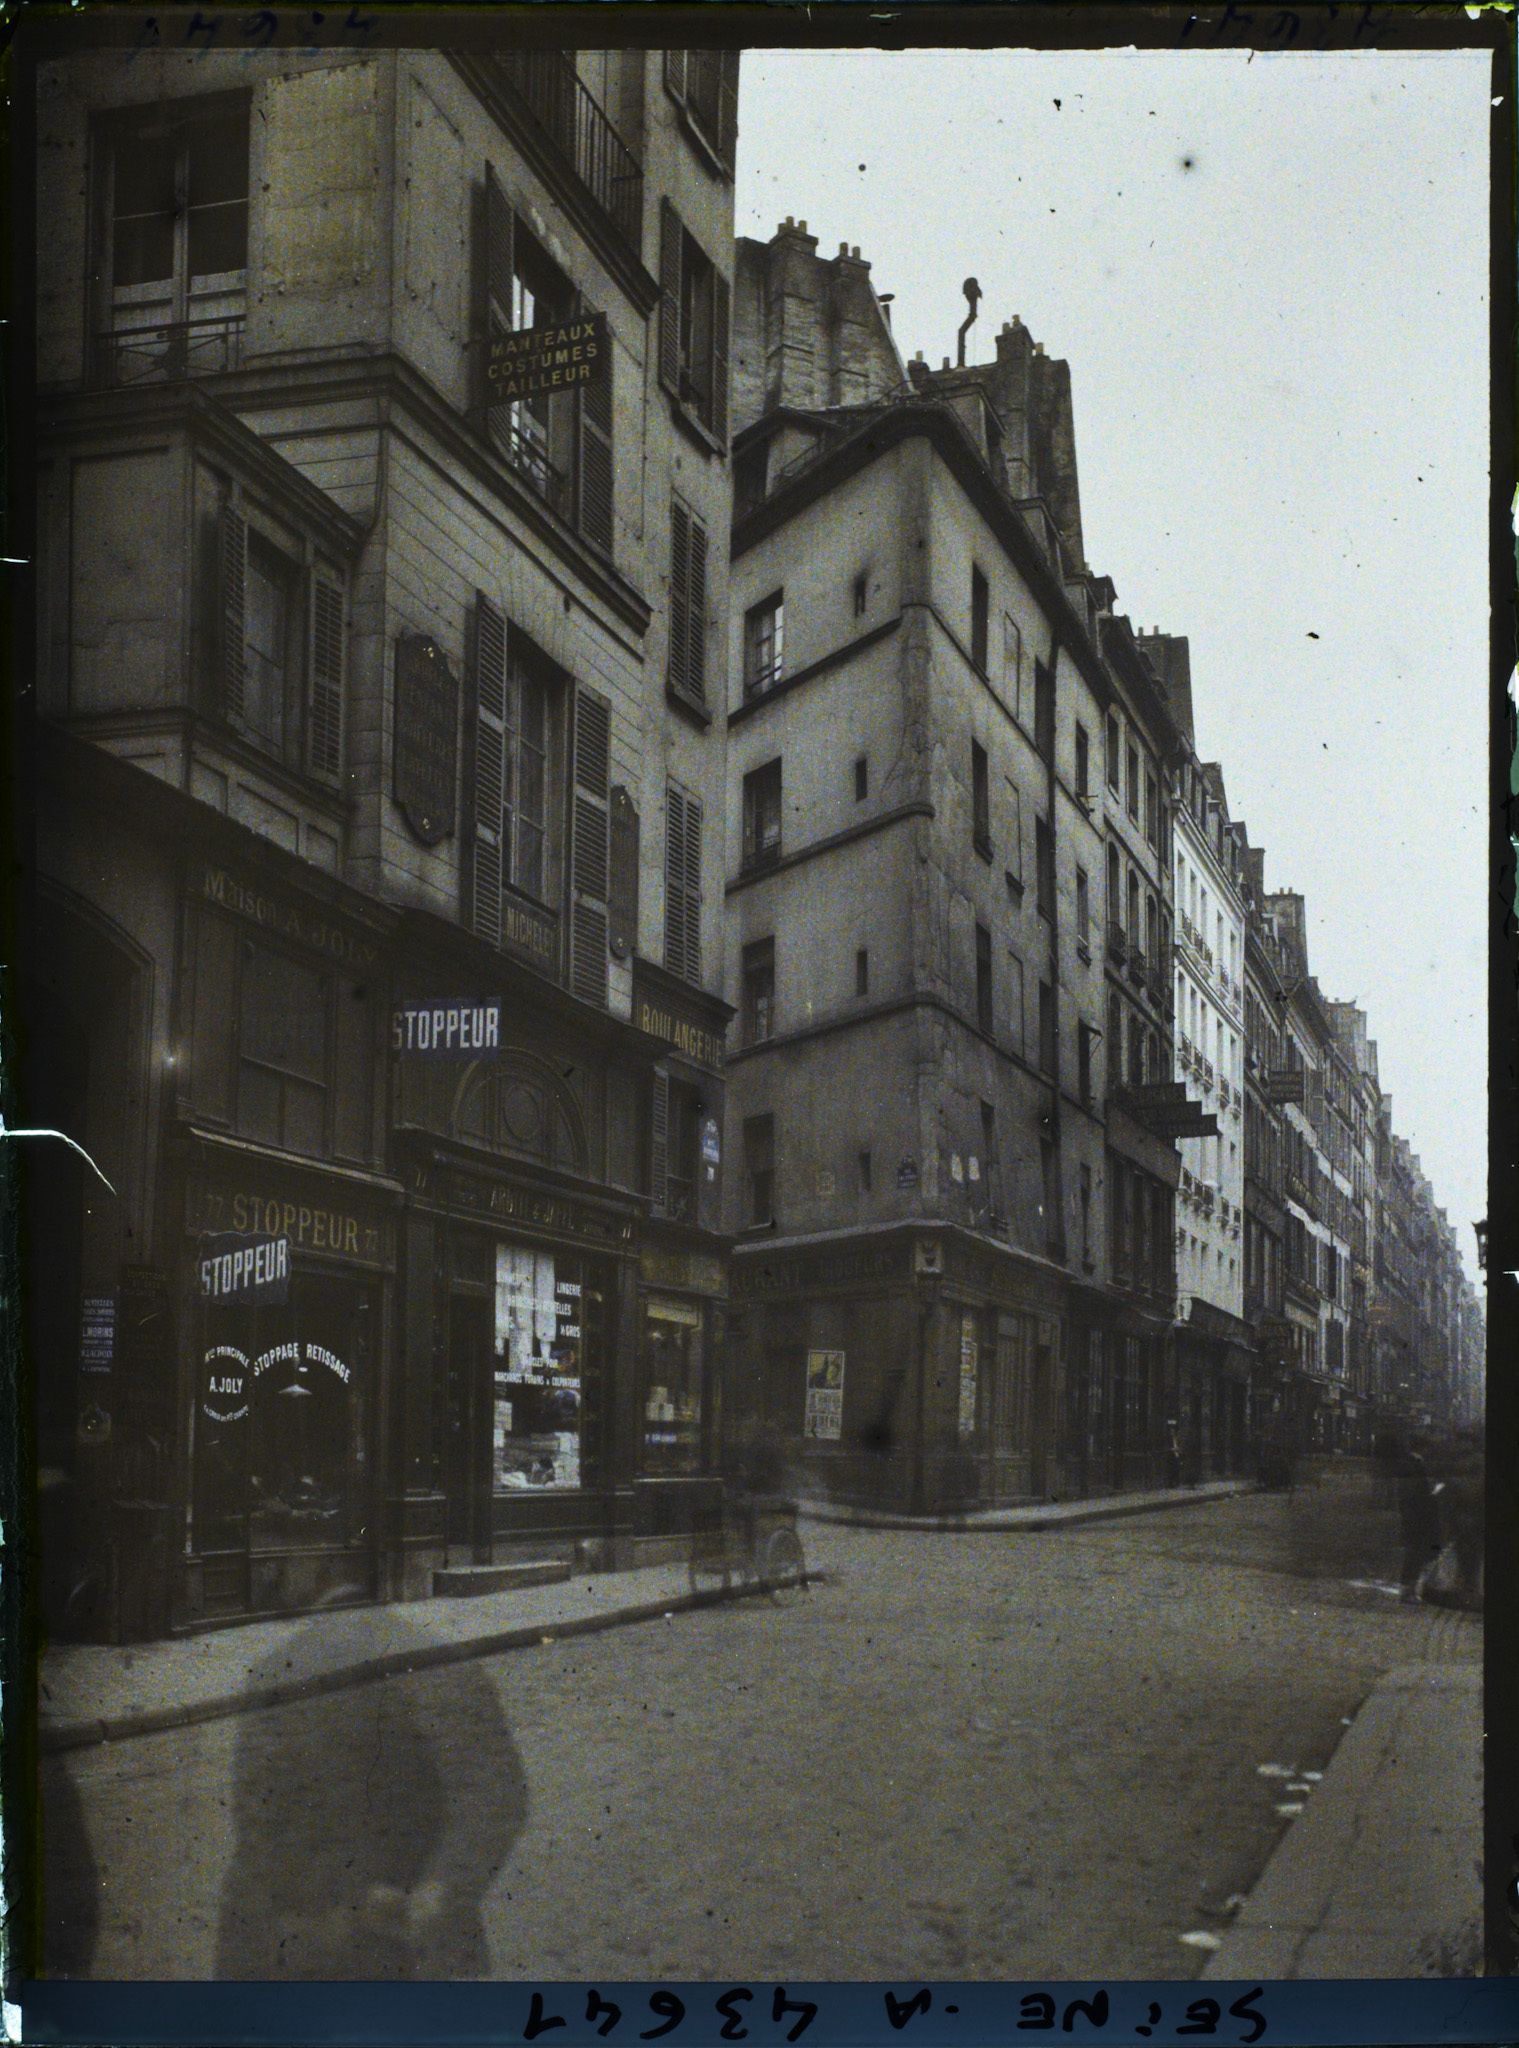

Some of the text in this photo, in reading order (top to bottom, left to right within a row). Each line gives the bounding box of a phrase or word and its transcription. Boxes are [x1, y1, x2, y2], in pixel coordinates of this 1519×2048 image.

[488, 343, 598, 379] COSTUMES
[490, 322, 595, 358] MANTEAUX
[496, 364, 590, 396] TAILLEUR
[393, 1008, 499, 1050] STOPPEUR
[642, 1004, 722, 1068] BOULANGERIE
[233, 1194, 358, 1252] STOPPEUR
[201, 1239, 288, 1295] STOPPEUR
[557, 1282, 581, 1297] LINGERIE
[254, 1342, 351, 1384] STOPPAGE RETISSAGE
[523, 1988, 817, 2041] 43641
